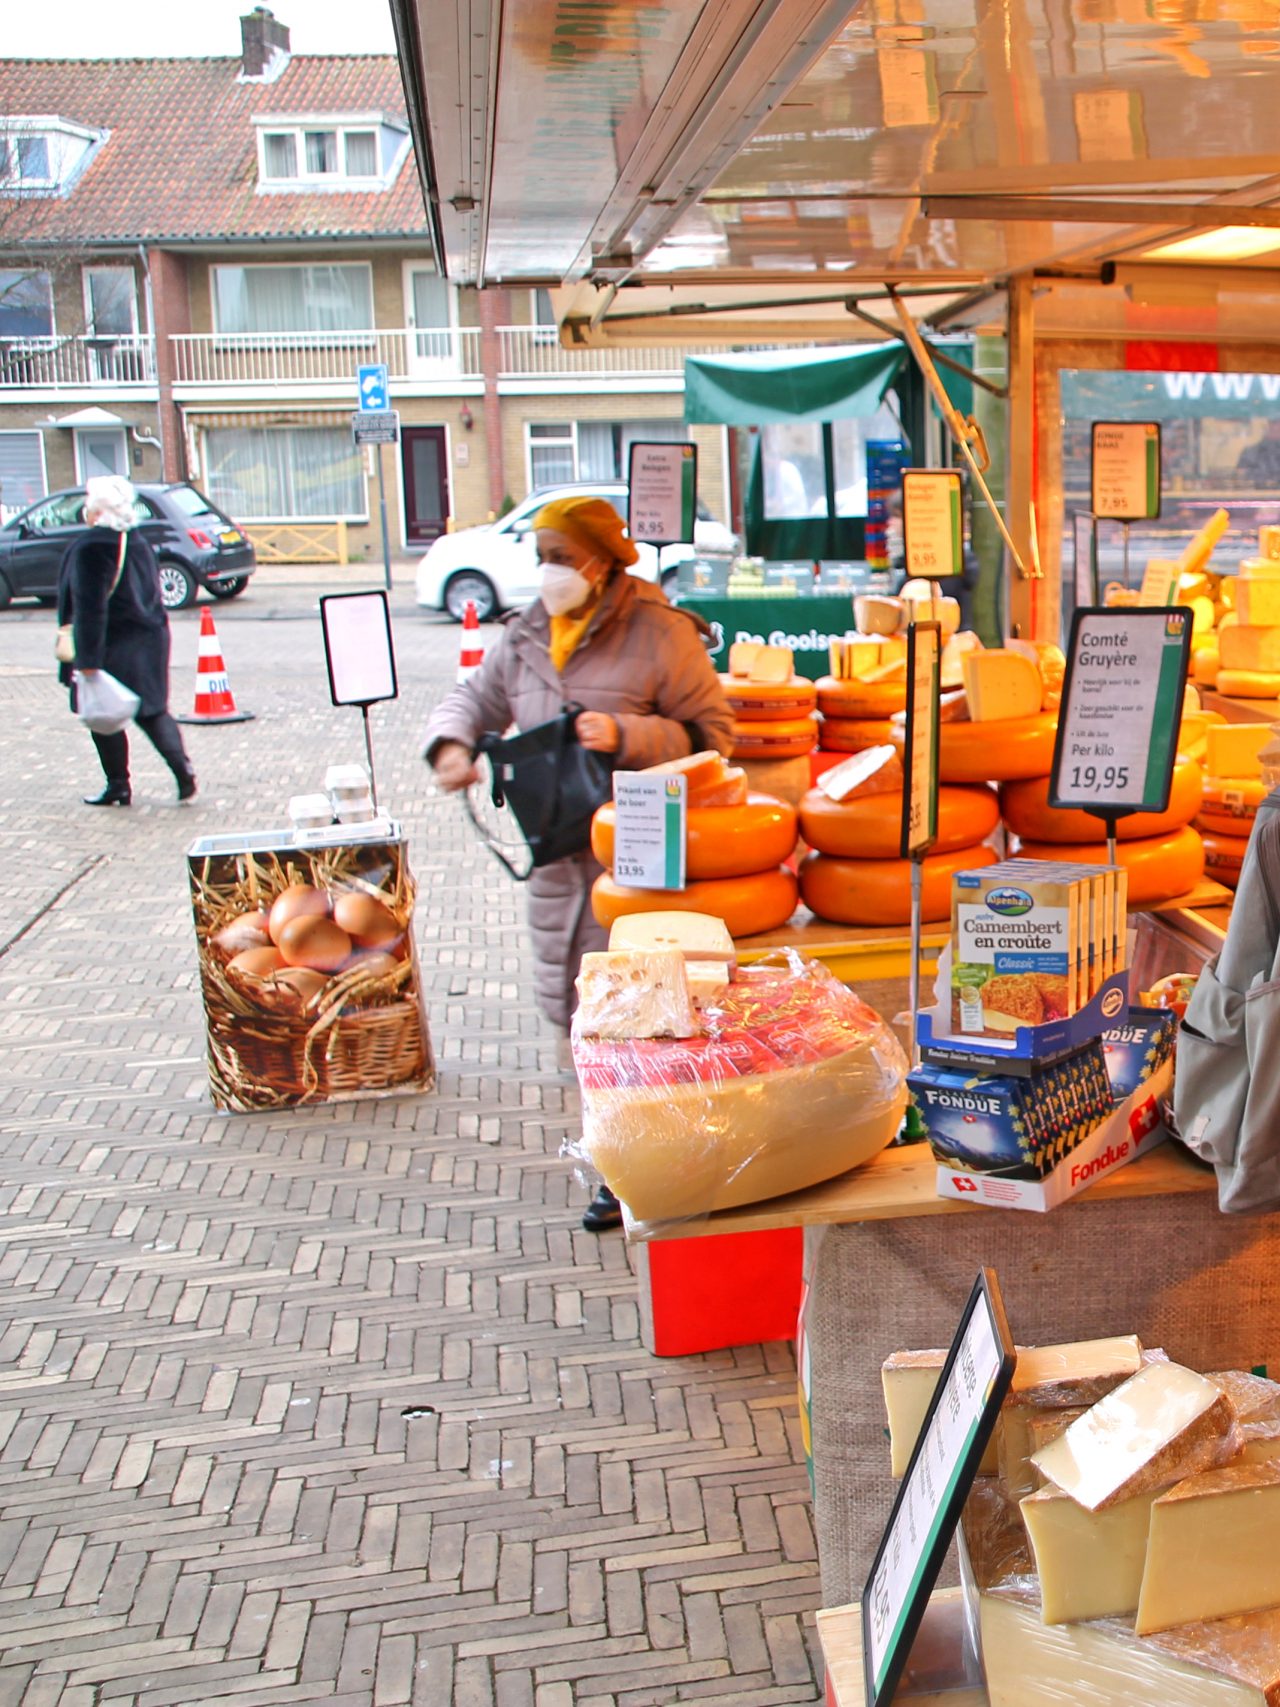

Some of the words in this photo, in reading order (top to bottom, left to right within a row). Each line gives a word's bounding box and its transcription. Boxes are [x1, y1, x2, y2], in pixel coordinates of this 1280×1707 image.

[1102, 497, 1128, 510] 7,95
[638, 521, 664, 535] 8,95
[1081, 631, 1129, 647] Comté
[1079, 652, 1137, 670] Gruyère
[1071, 743, 1092, 756] Per
[1094, 743, 1115, 756] kilo
[1070, 766, 1129, 792] 19,95
[617, 785, 641, 795] Pikant
[618, 864, 645, 877] 13,95
[964, 919, 1062, 935] Camembert
[974, 937, 994, 948] en
[998, 935, 1052, 949] croûte
[997, 957, 1035, 970] Classic
[925, 1090, 1002, 1116] FONDUE
[1070, 1140, 1129, 1187] Fondue
